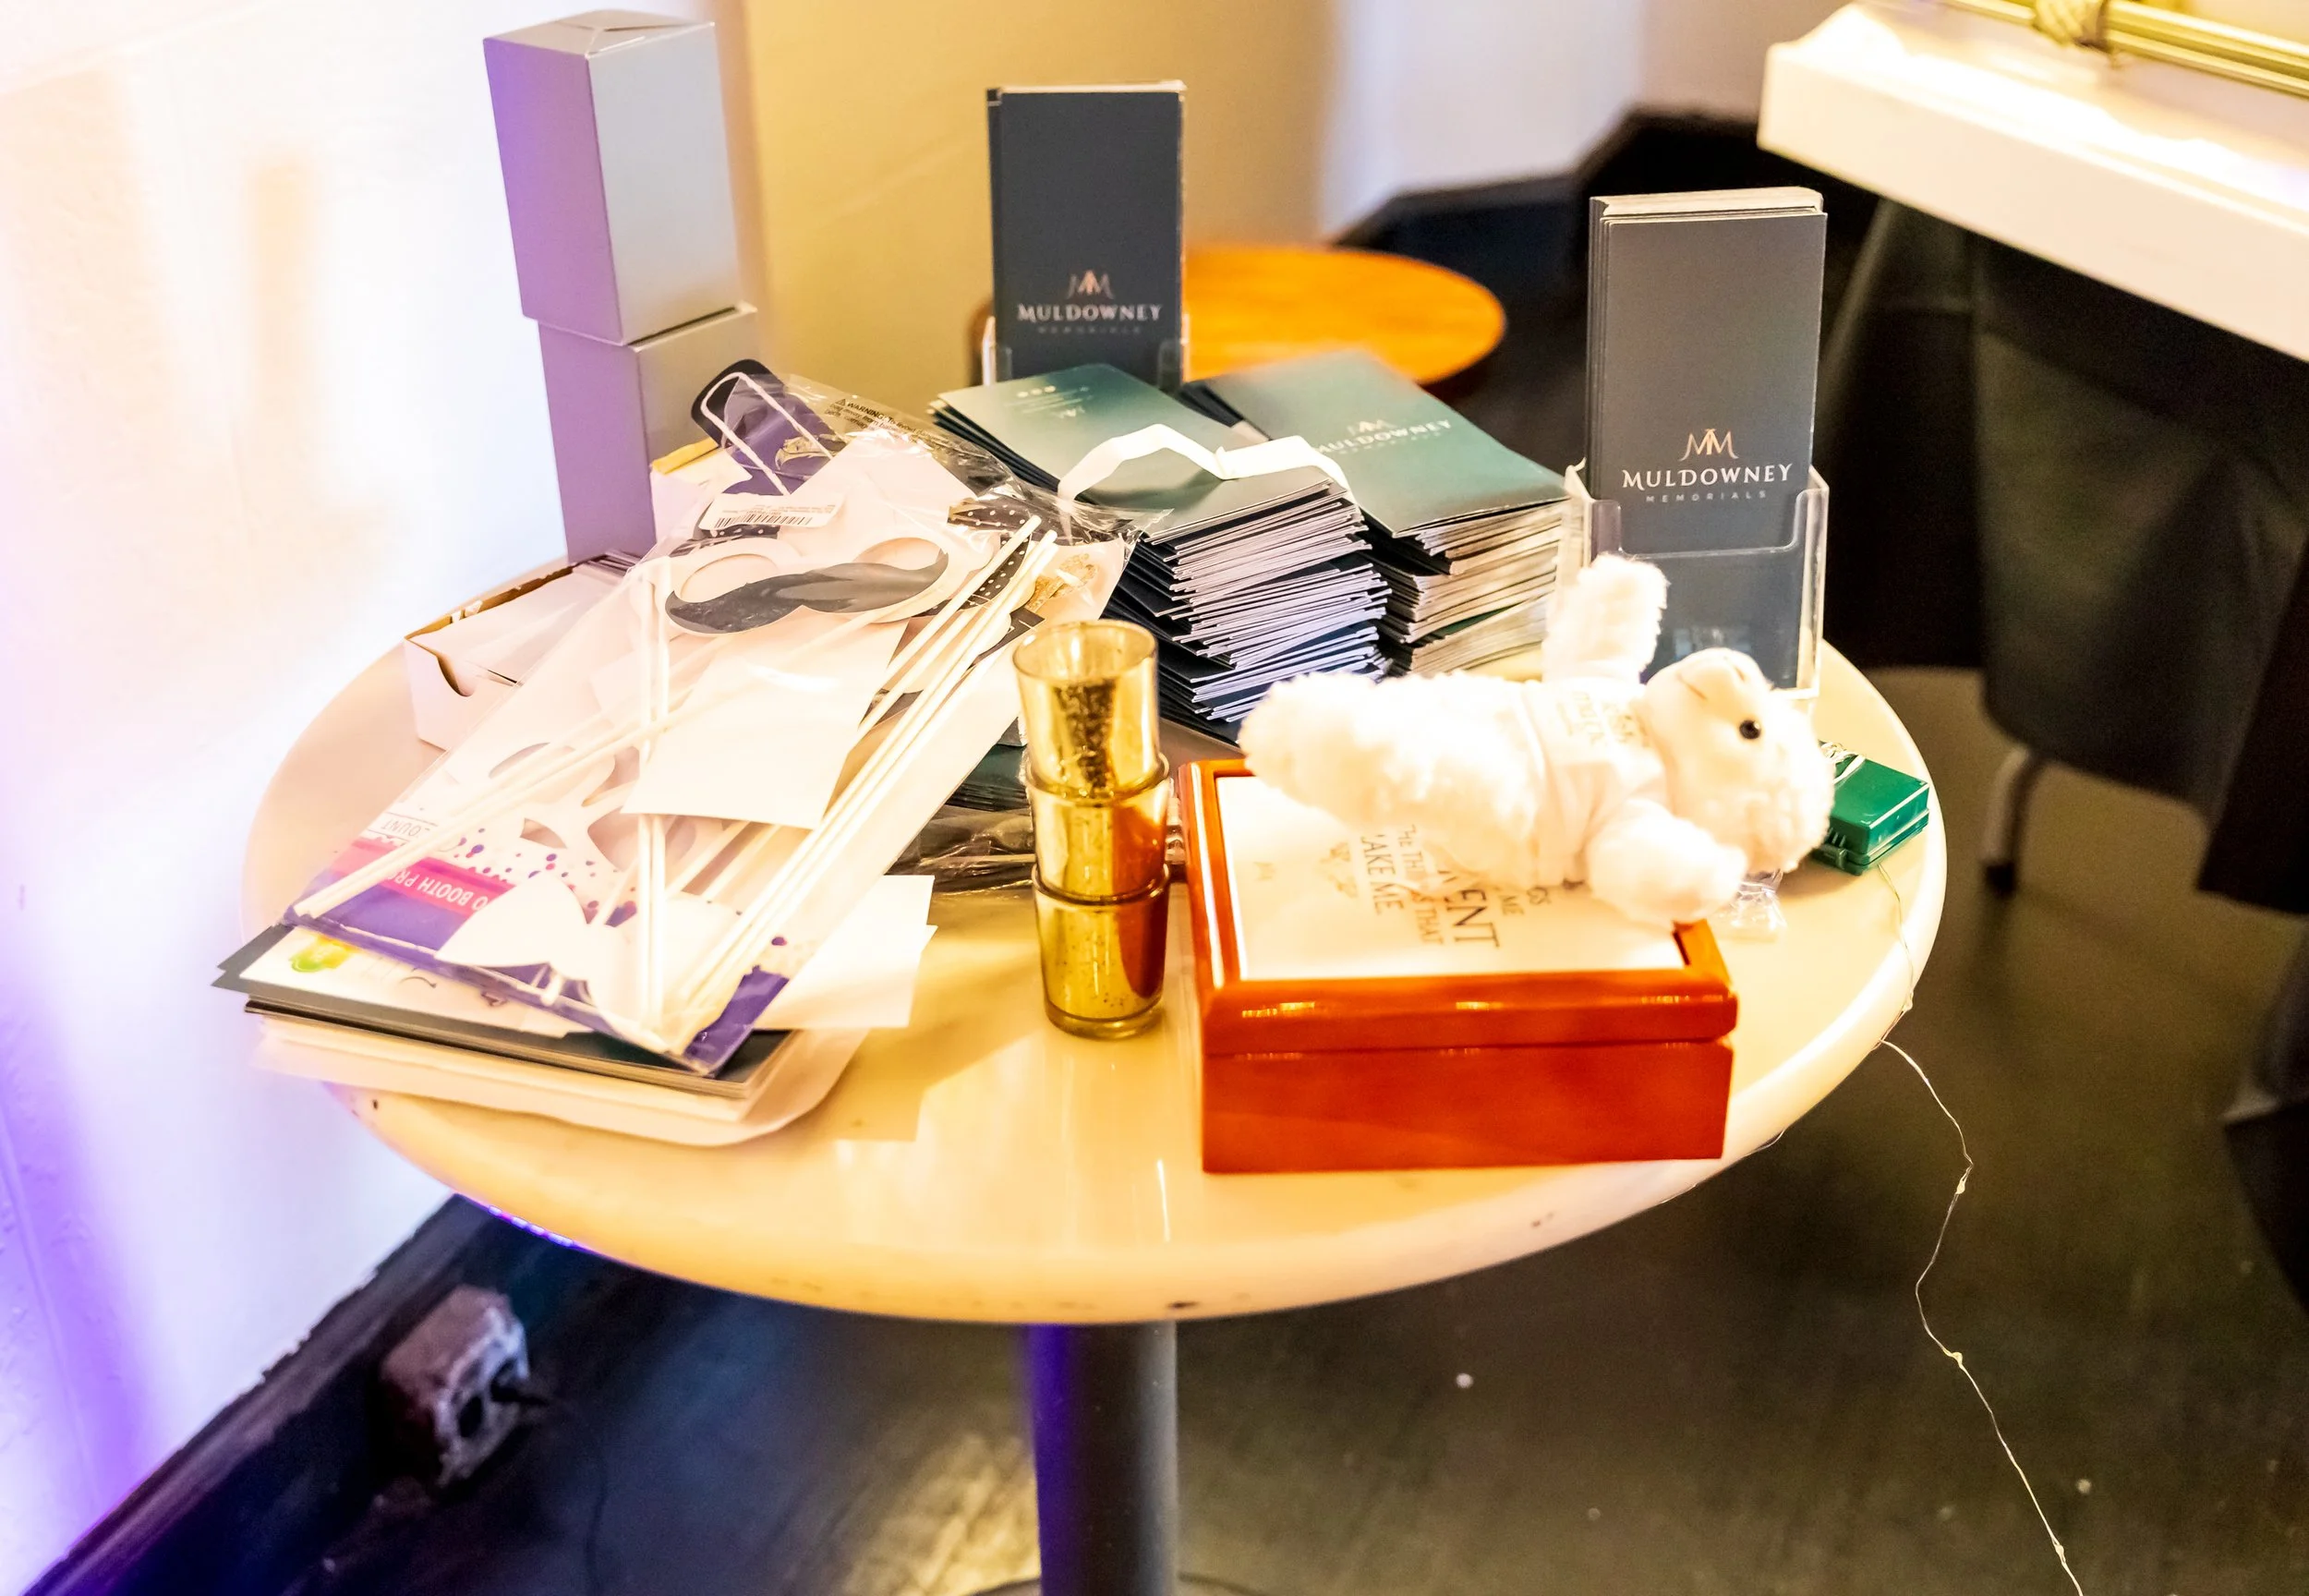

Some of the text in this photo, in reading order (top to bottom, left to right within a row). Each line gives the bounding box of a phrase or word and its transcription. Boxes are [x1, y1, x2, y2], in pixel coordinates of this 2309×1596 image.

[1017, 303, 1163, 323] MULDOWNEY
[1622, 463, 1793, 490] MULDOWNEY
[1646, 490, 1767, 503] MEMORIALS
[381, 818, 430, 838] OUNT
[417, 877, 474, 906] BOOTH
[1415, 907, 1445, 945] THAT
